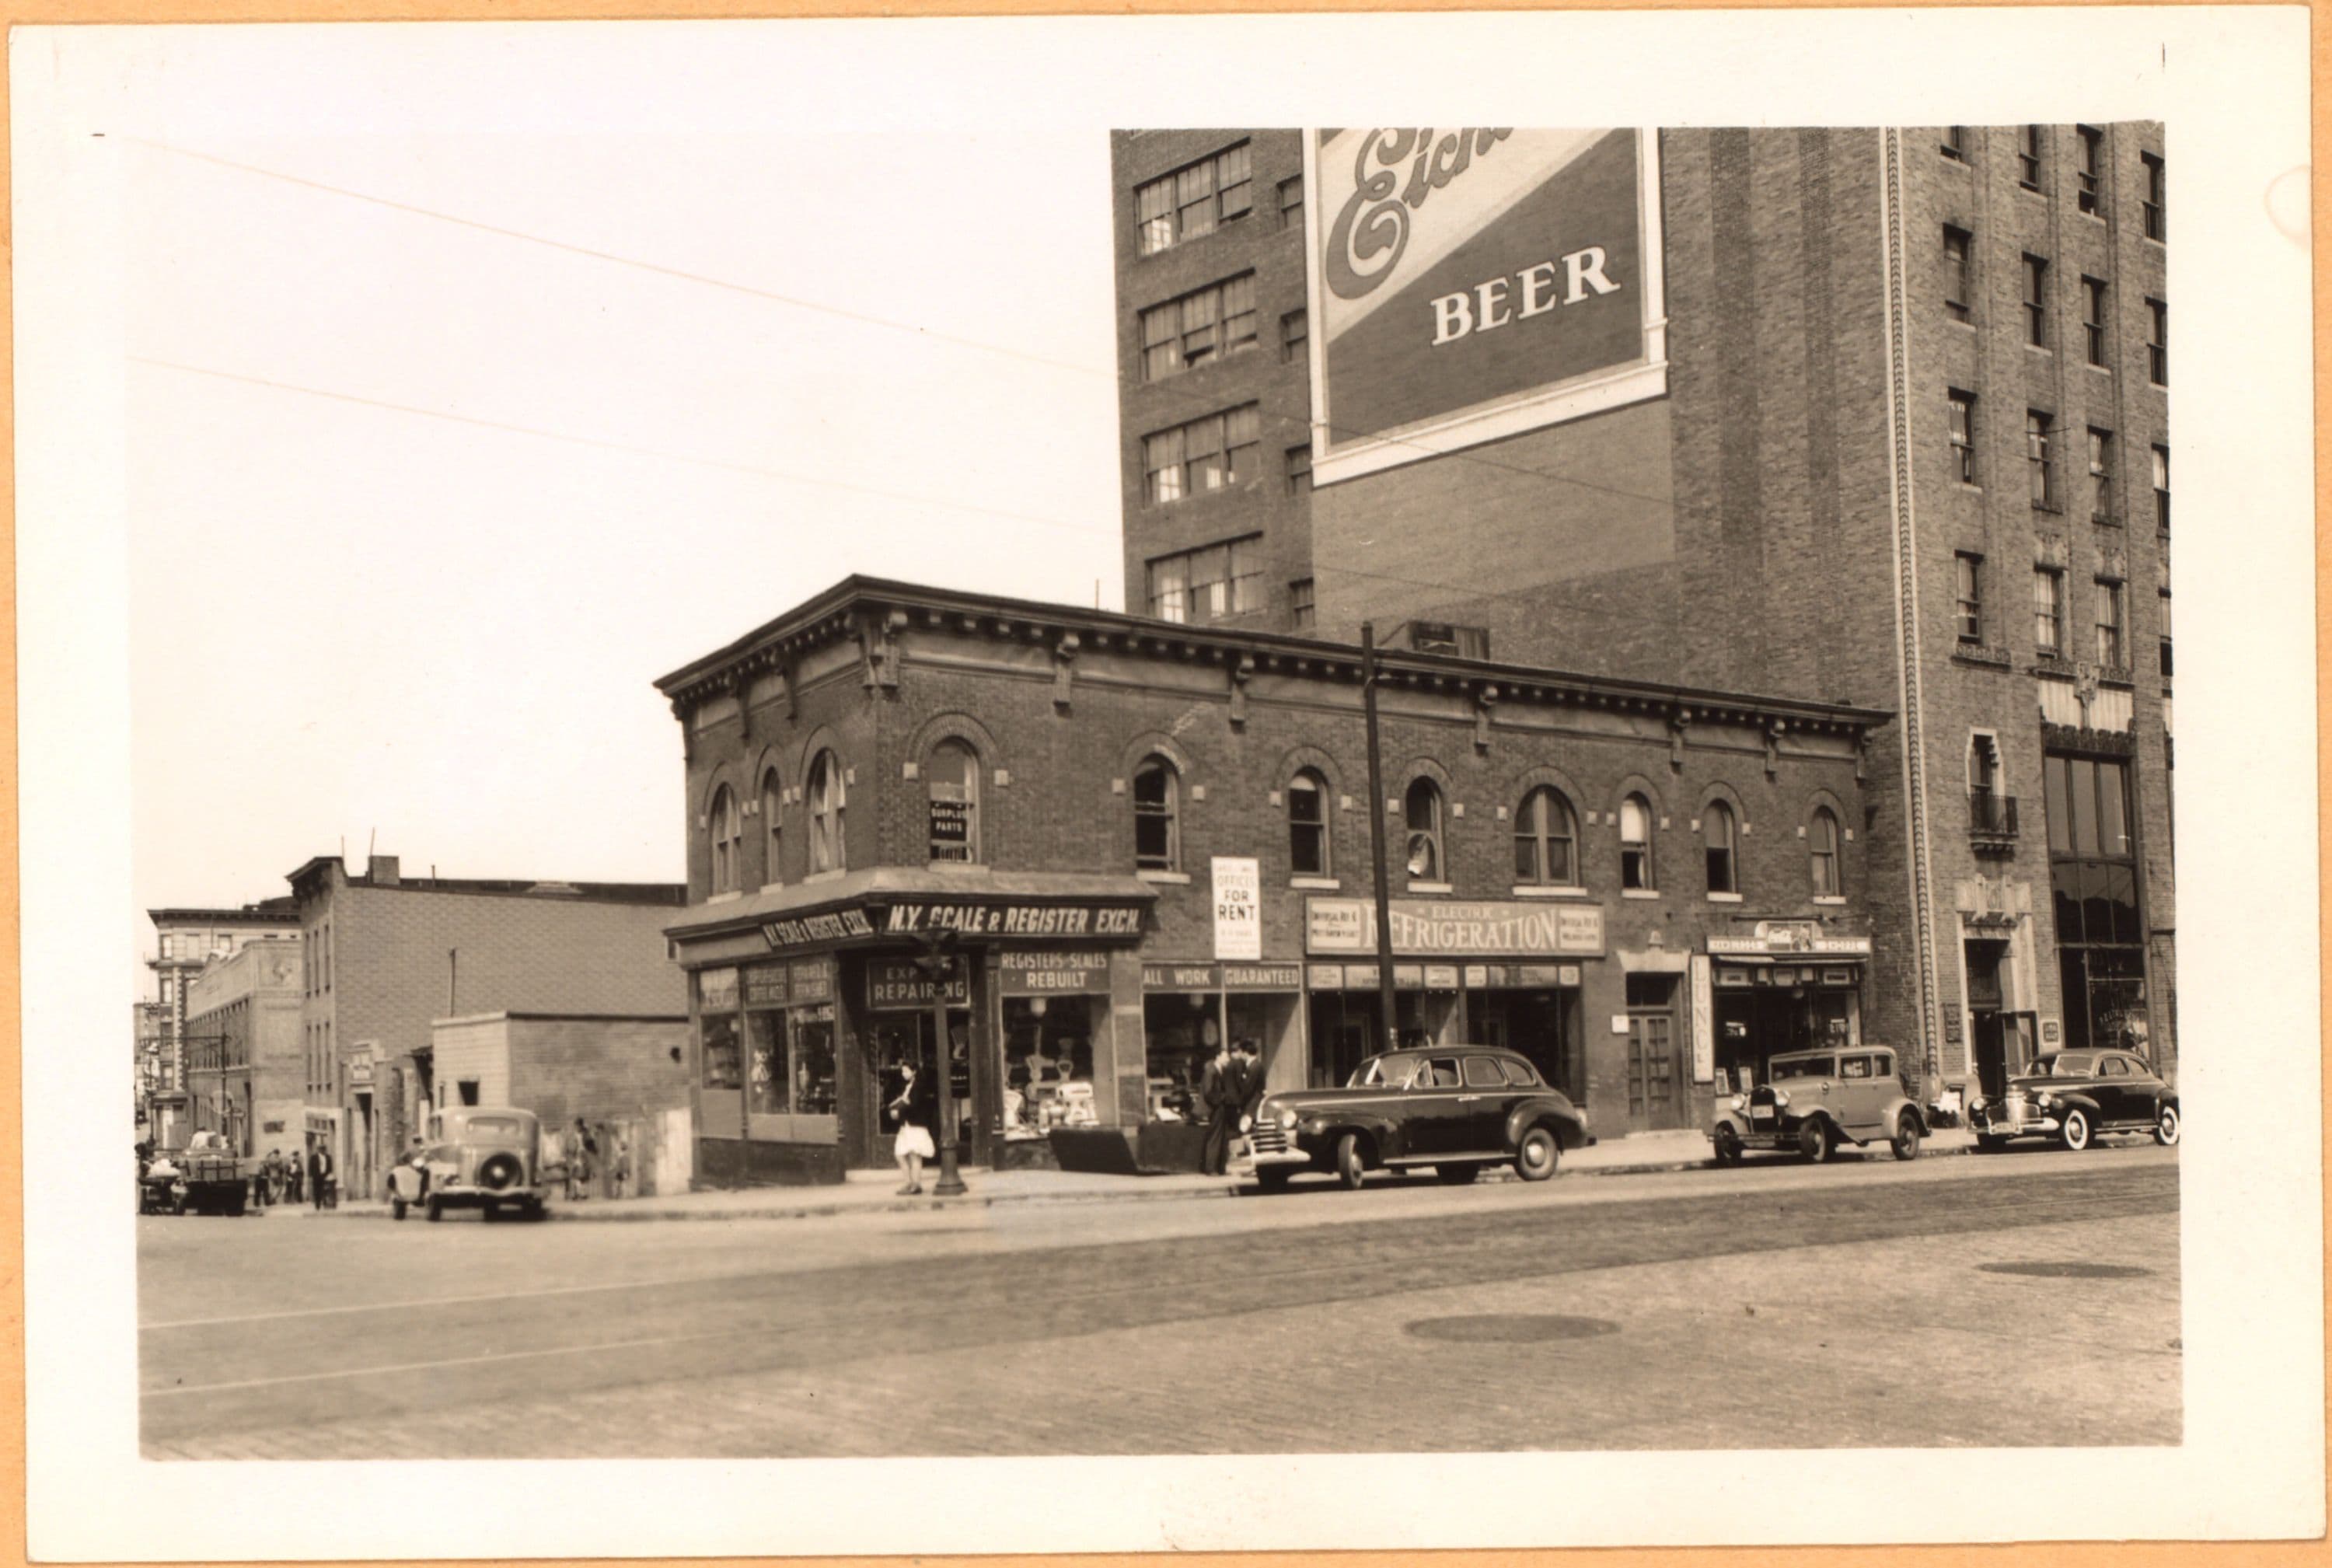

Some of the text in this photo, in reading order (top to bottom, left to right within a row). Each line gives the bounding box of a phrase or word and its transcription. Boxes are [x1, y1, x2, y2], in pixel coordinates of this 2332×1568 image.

[1430, 246, 1622, 347] BEER
[936, 821, 962, 833] PARTS
[1224, 889, 1249, 902] FOR
[927, 906, 986, 932] SCALE
[988, 911, 1001, 932] &
[1004, 907, 1089, 933] REGISTER
[1218, 904, 1255, 920] RENT
[1027, 971, 1087, 988] REBUILT
[1143, 969, 1164, 985] ALL
[1173, 969, 1210, 986] WORK
[1224, 969, 1299, 986] GUARANTEED
[874, 981, 964, 1000] REPAIRNG
